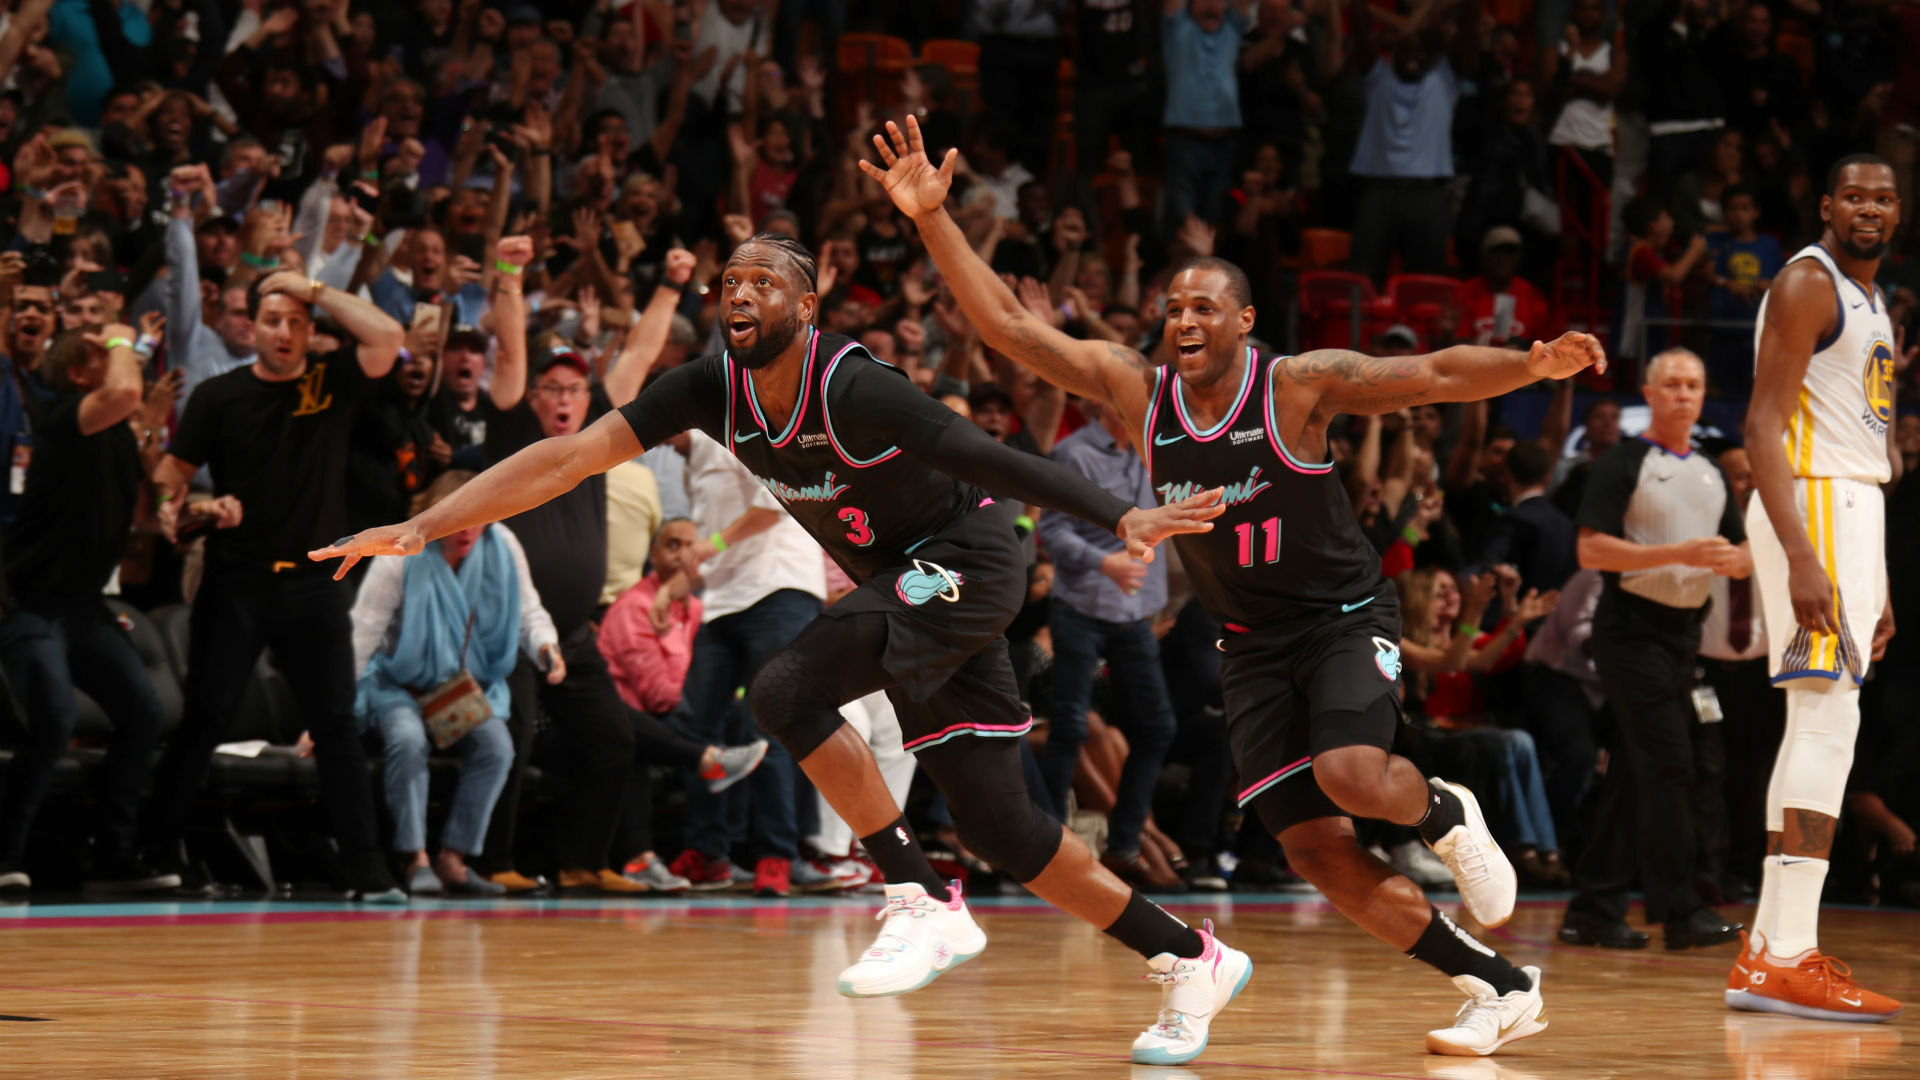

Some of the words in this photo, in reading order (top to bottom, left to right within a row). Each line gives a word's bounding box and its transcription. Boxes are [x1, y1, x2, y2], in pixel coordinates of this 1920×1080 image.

[797, 432, 828, 443] Ultimate
[1230, 428, 1264, 441] Ultimate
[1232, 434, 1264, 445] SOFTWARE
[801, 440, 829, 449] SOFTWARE
[837, 507, 875, 546] 3
[1234, 517, 1281, 567] 11
